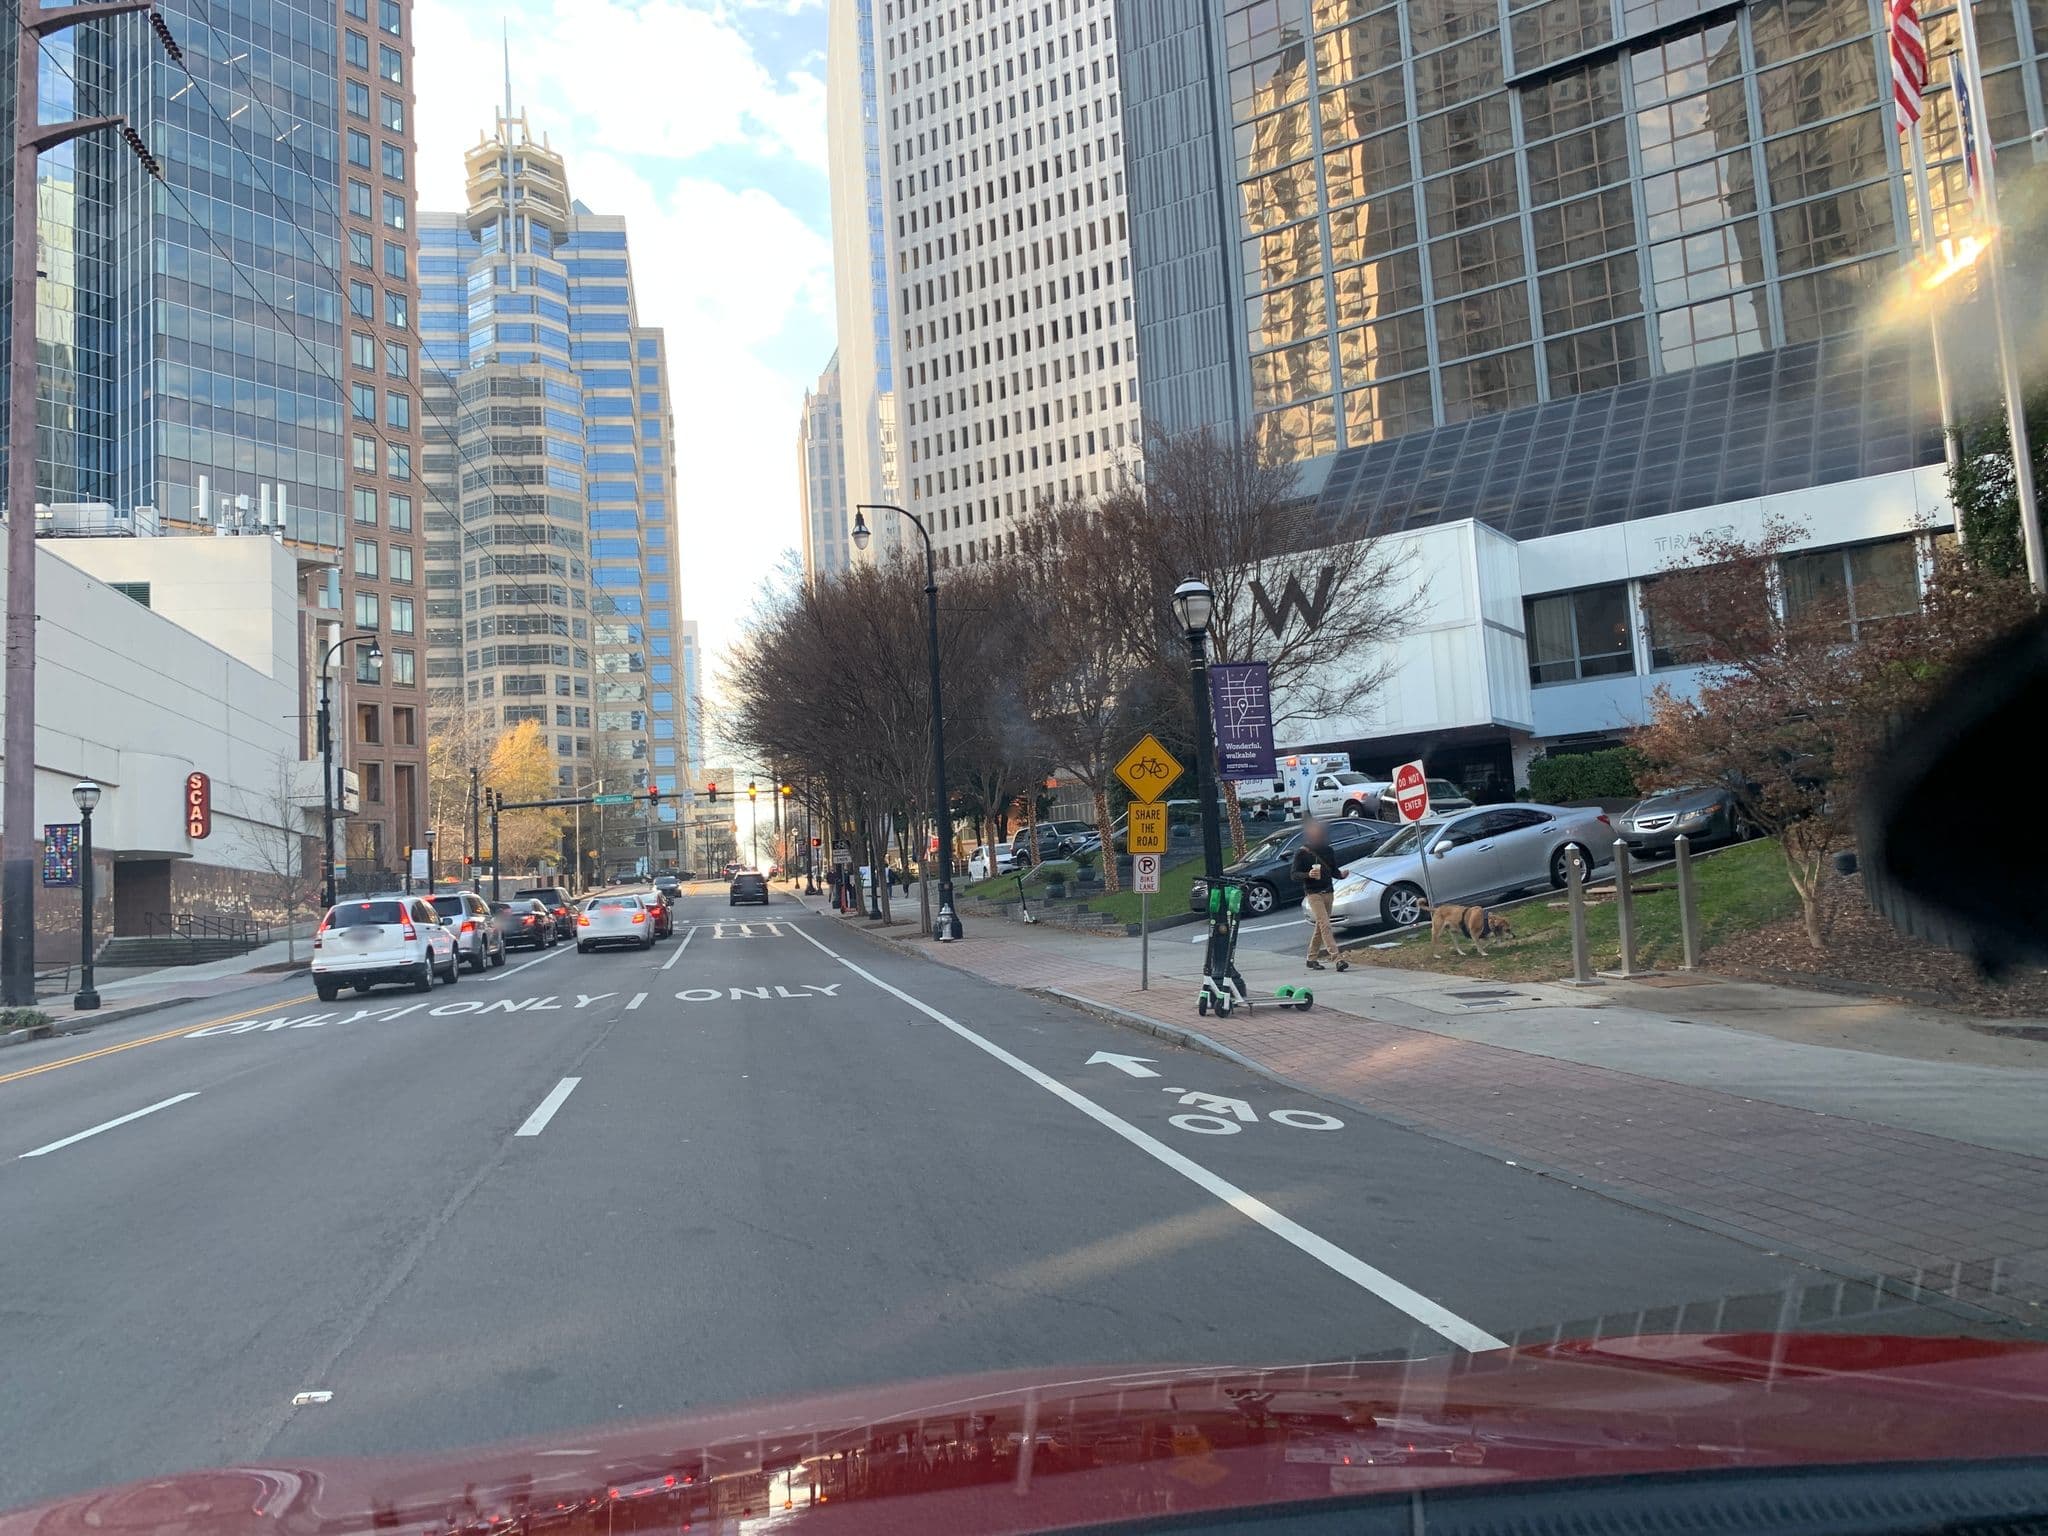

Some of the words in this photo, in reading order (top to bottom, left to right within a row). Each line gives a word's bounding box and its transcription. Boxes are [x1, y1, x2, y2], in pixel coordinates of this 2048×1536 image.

[1248, 566, 1336, 640] W
[1225, 742, 1262, 751] Wonderful,
[1398, 777, 1407, 787] DO
[1408, 773, 1420, 784] NOT
[190, 774, 203, 837] SCAD
[1404, 799, 1422, 811] ENTER
[1135, 809, 1160, 820] SHARE
[1141, 822, 1155, 833] THE
[1136, 836, 1159, 847] ROAD
[674, 983, 843, 1002] ONLY
[428, 992, 620, 1016] ONLY
[183, 1006, 403, 1039] ONLY
